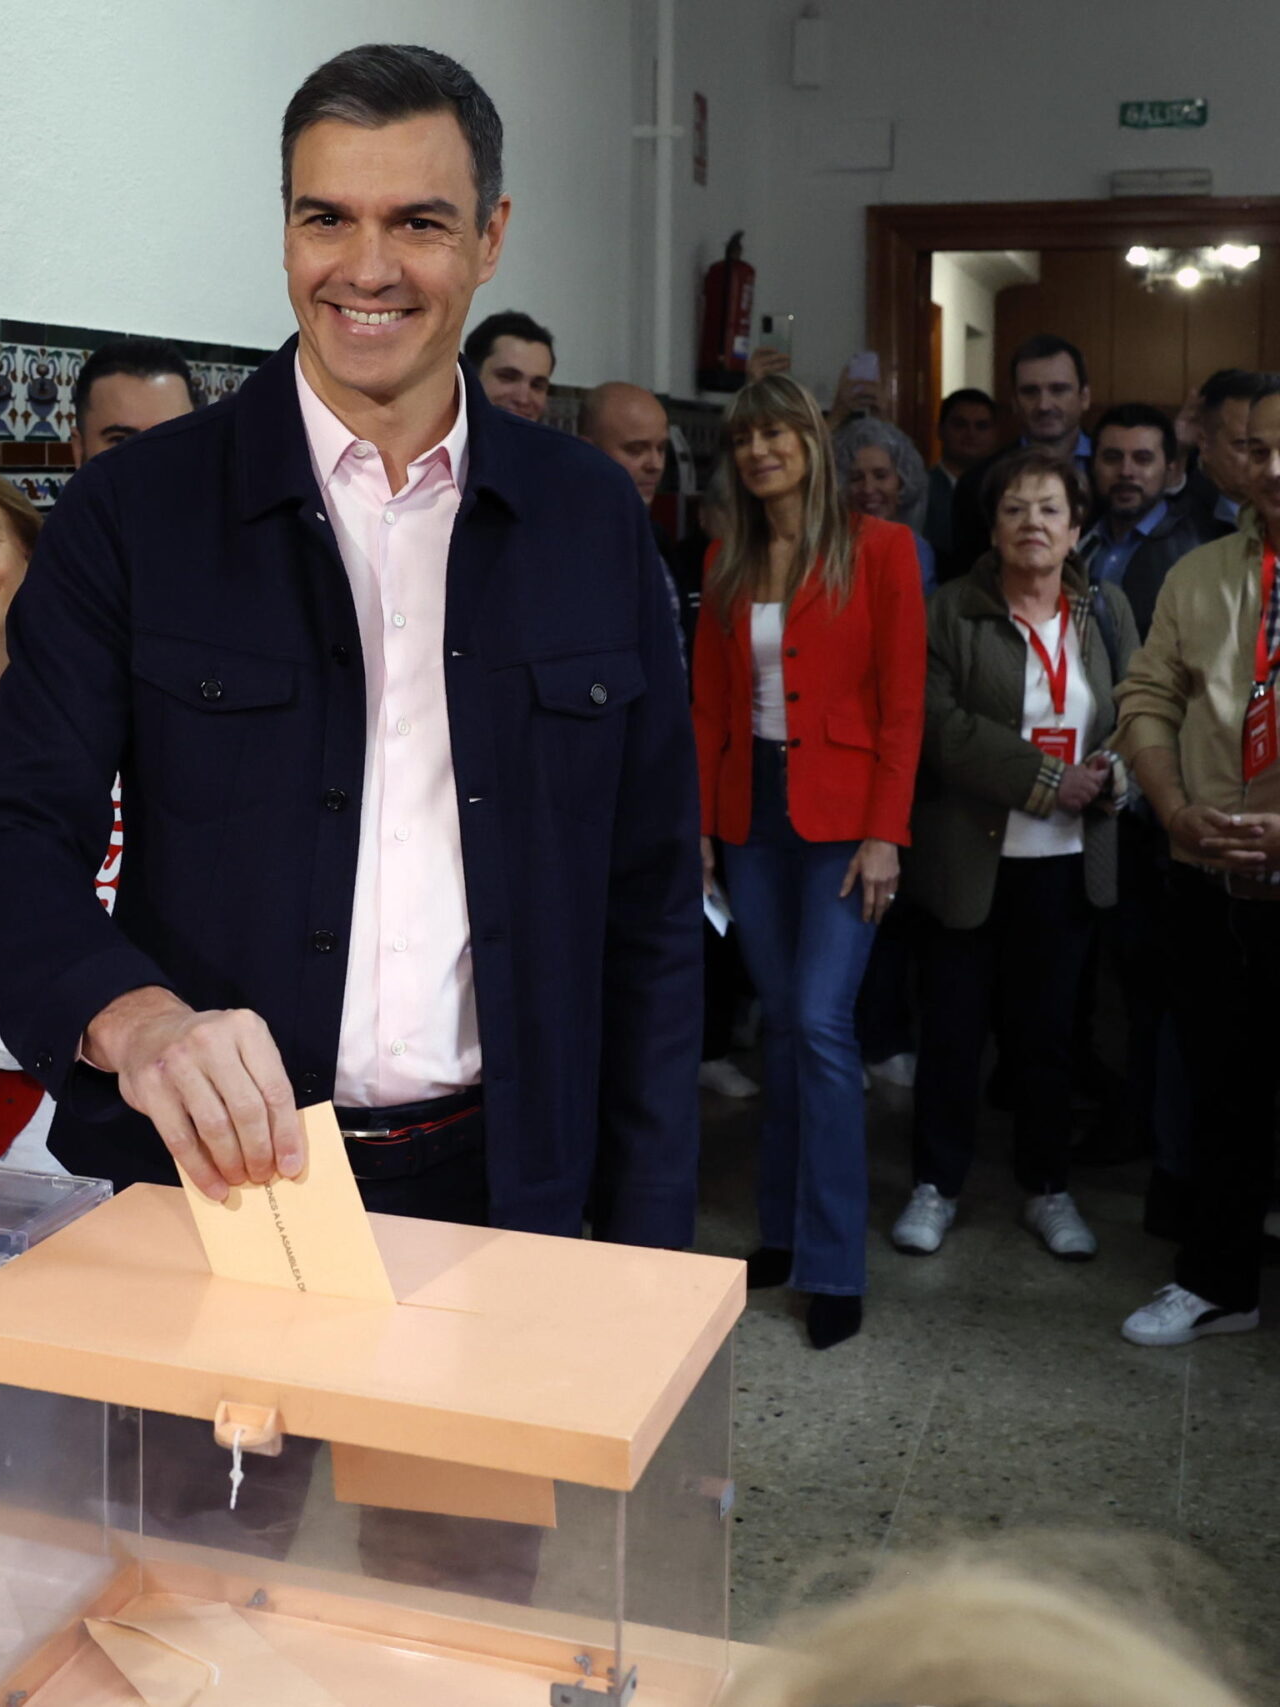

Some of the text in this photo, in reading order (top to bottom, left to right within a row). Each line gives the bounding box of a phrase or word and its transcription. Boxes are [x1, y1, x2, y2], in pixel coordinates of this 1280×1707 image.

[273, 1212, 281, 1221] A
[275, 1220, 286, 1233] LA
[280, 1234, 302, 1282] ASAMBLEA
